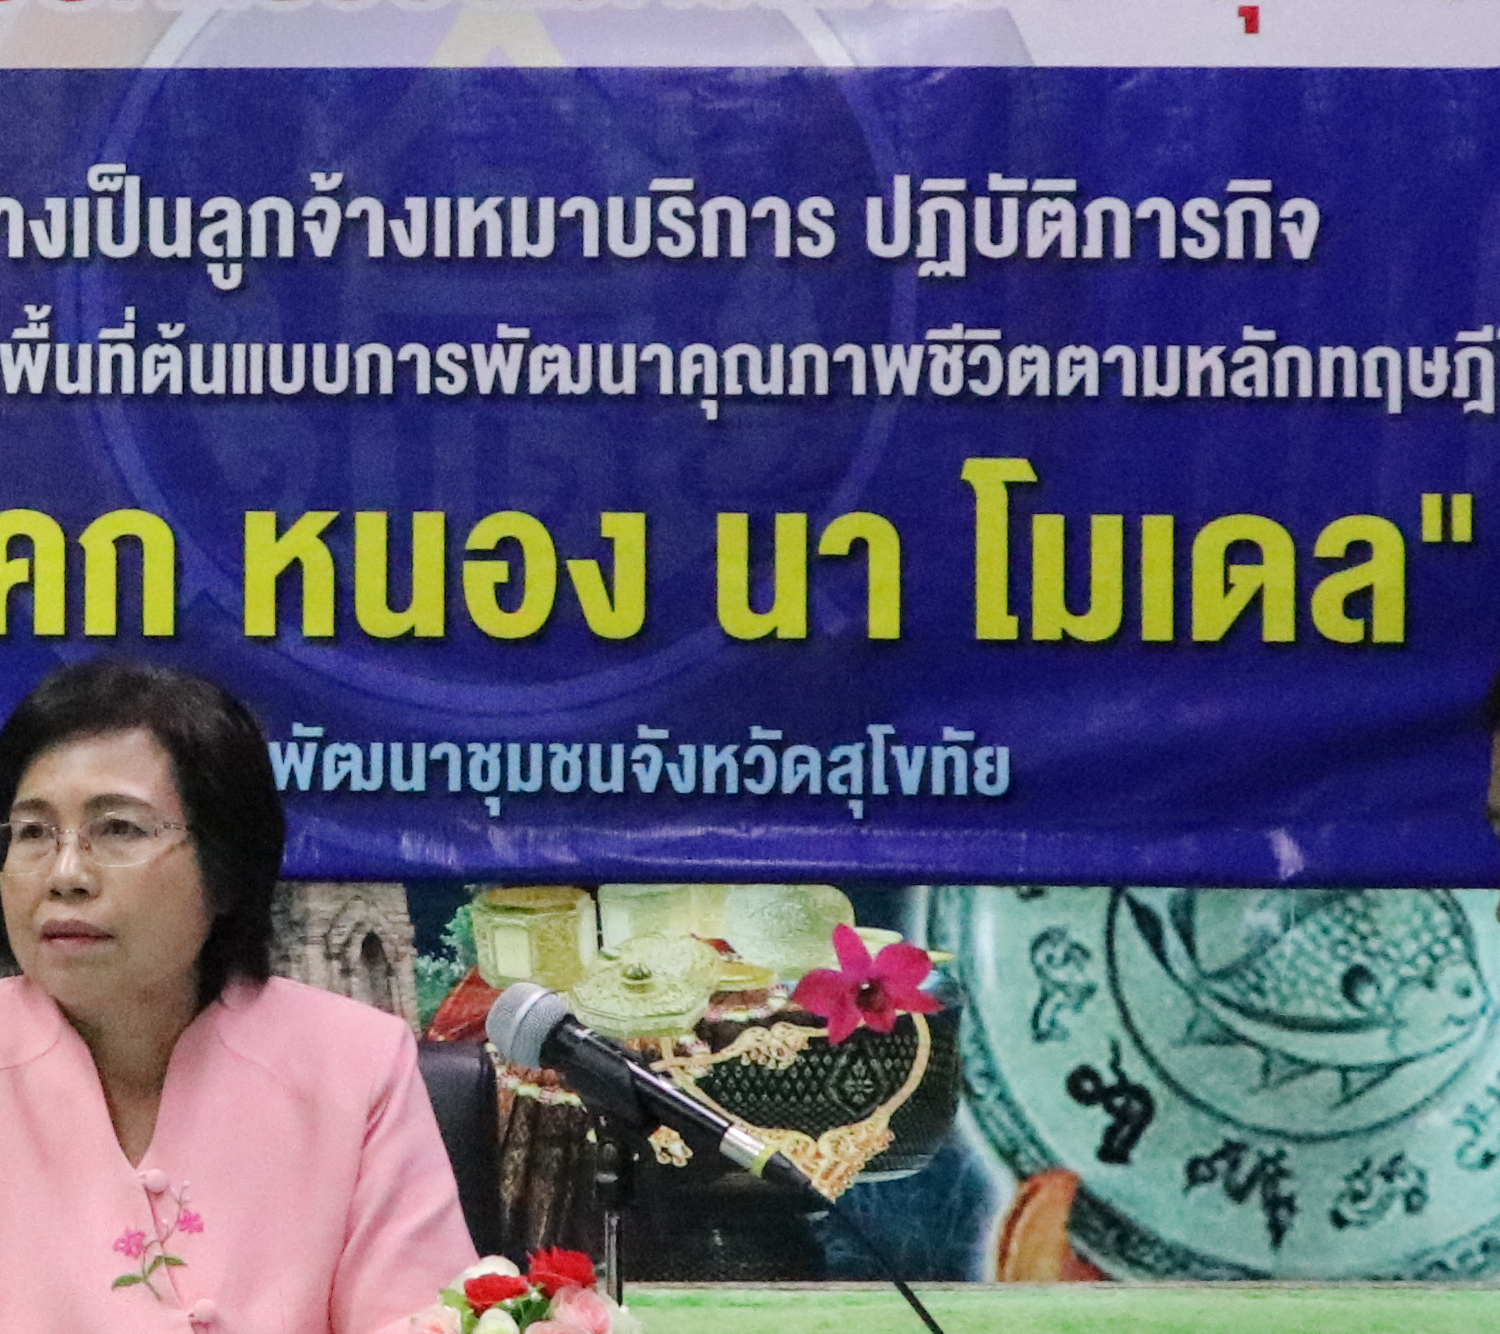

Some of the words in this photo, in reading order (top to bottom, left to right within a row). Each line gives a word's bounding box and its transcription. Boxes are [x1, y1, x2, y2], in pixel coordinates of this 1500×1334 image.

[865, 172, 1321, 278] ปฏิบัติภารกิจ
[243, 509, 647, 640] หนอง
[715, 510, 902, 641] นา
